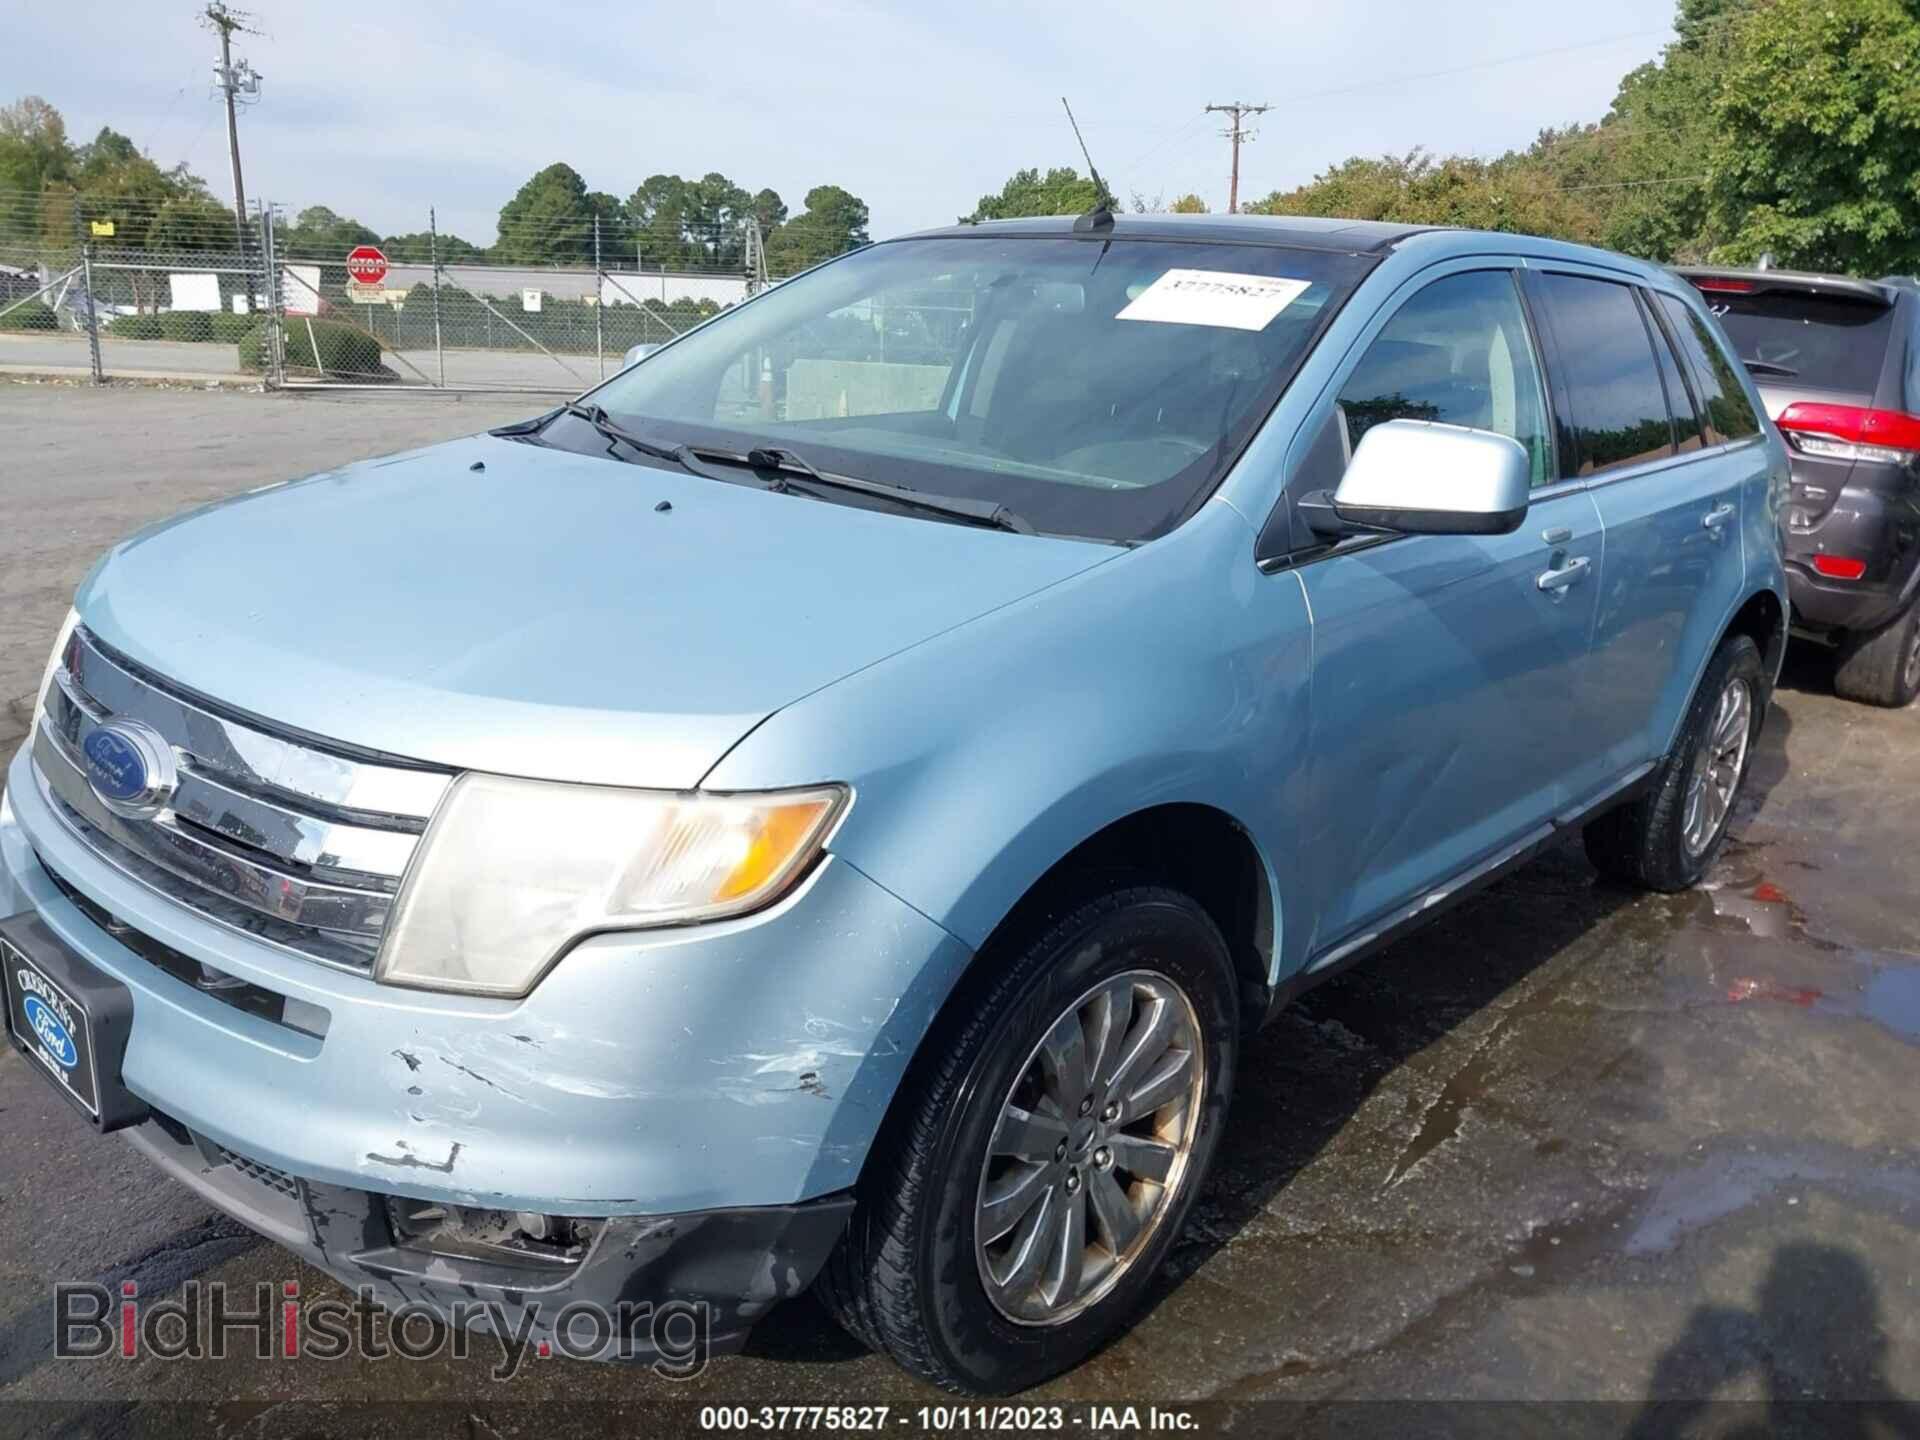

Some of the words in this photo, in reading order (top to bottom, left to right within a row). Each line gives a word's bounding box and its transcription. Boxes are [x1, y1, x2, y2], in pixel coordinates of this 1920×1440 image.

[351, 258, 384, 273] STOP
[17, 969, 77, 1038] CRESCENT
[36, 1007, 66, 1057] Ford
